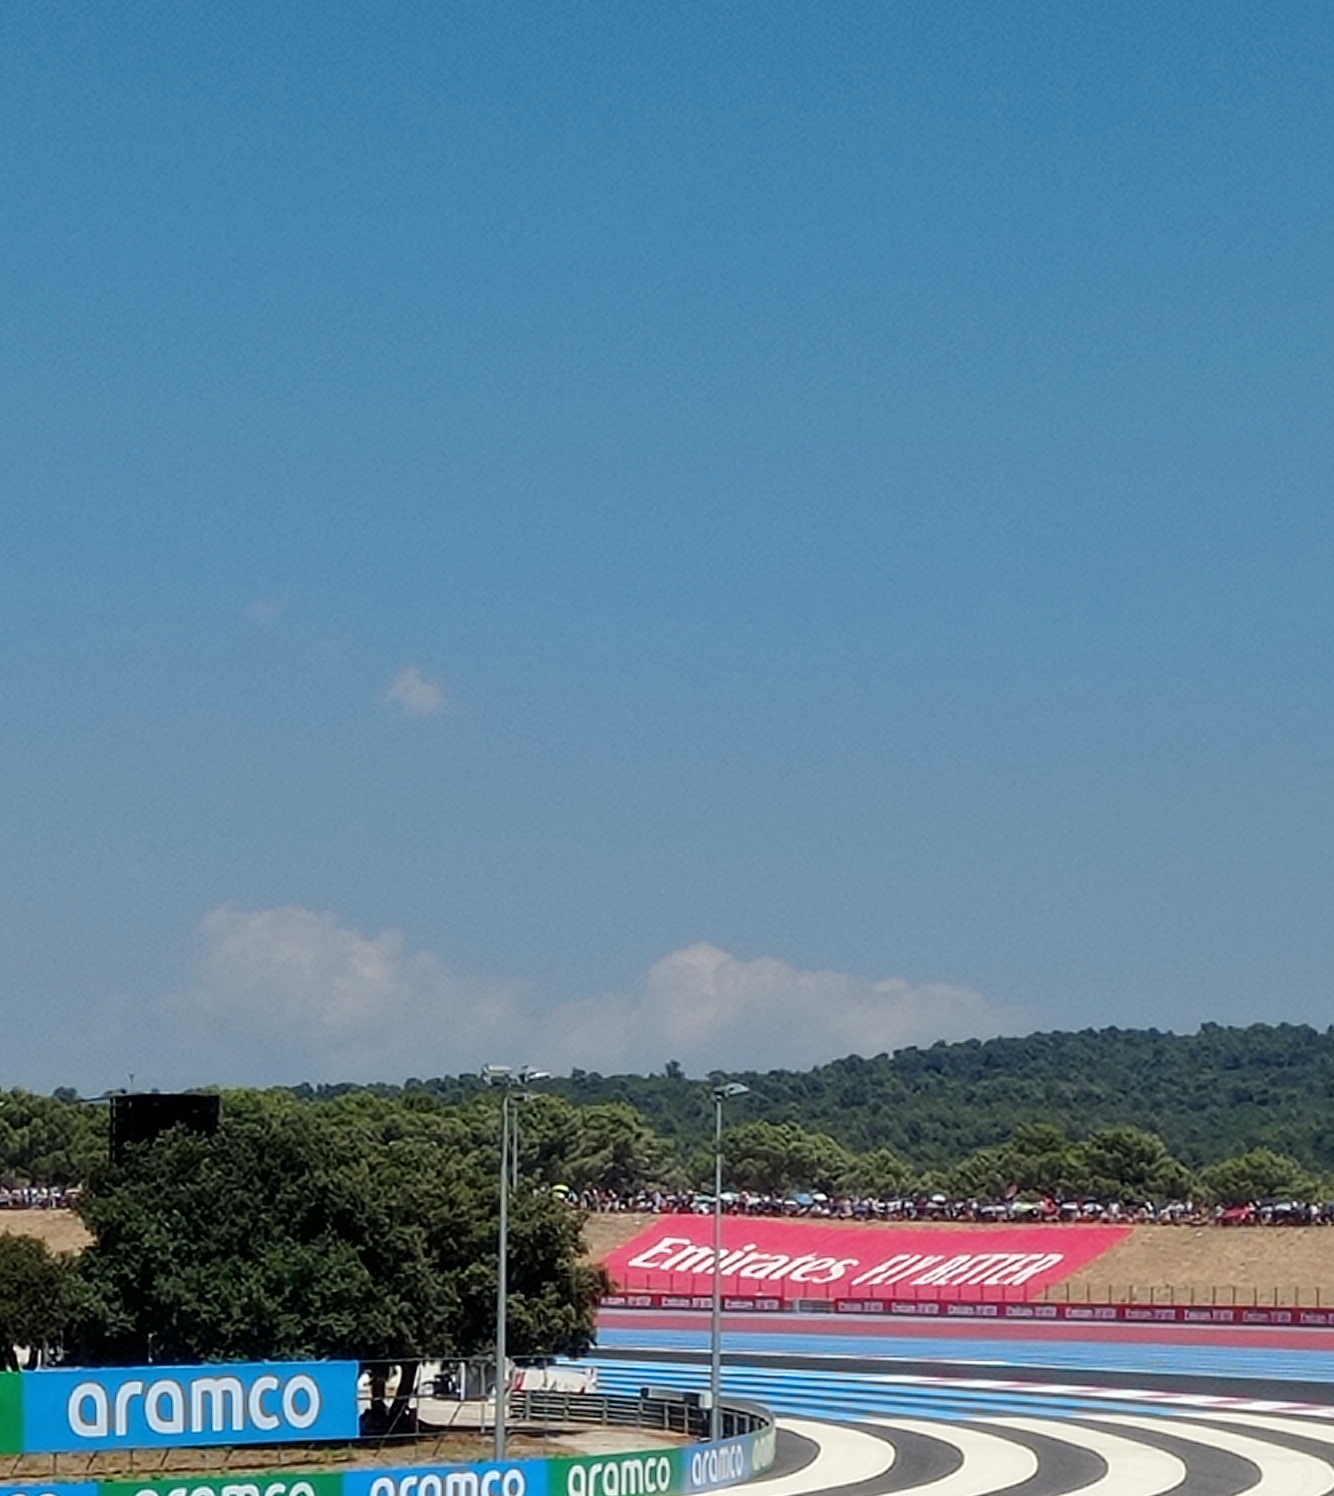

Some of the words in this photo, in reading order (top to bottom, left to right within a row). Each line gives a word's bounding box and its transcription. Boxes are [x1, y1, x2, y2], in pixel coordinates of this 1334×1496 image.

[628, 1236, 859, 1283] Emirates
[852, 1253, 946, 1285] FLY
[910, 1253, 1064, 1285] BETTER
[69, 1374, 320, 1437] aramco
[692, 1444, 744, 1486] aramco
